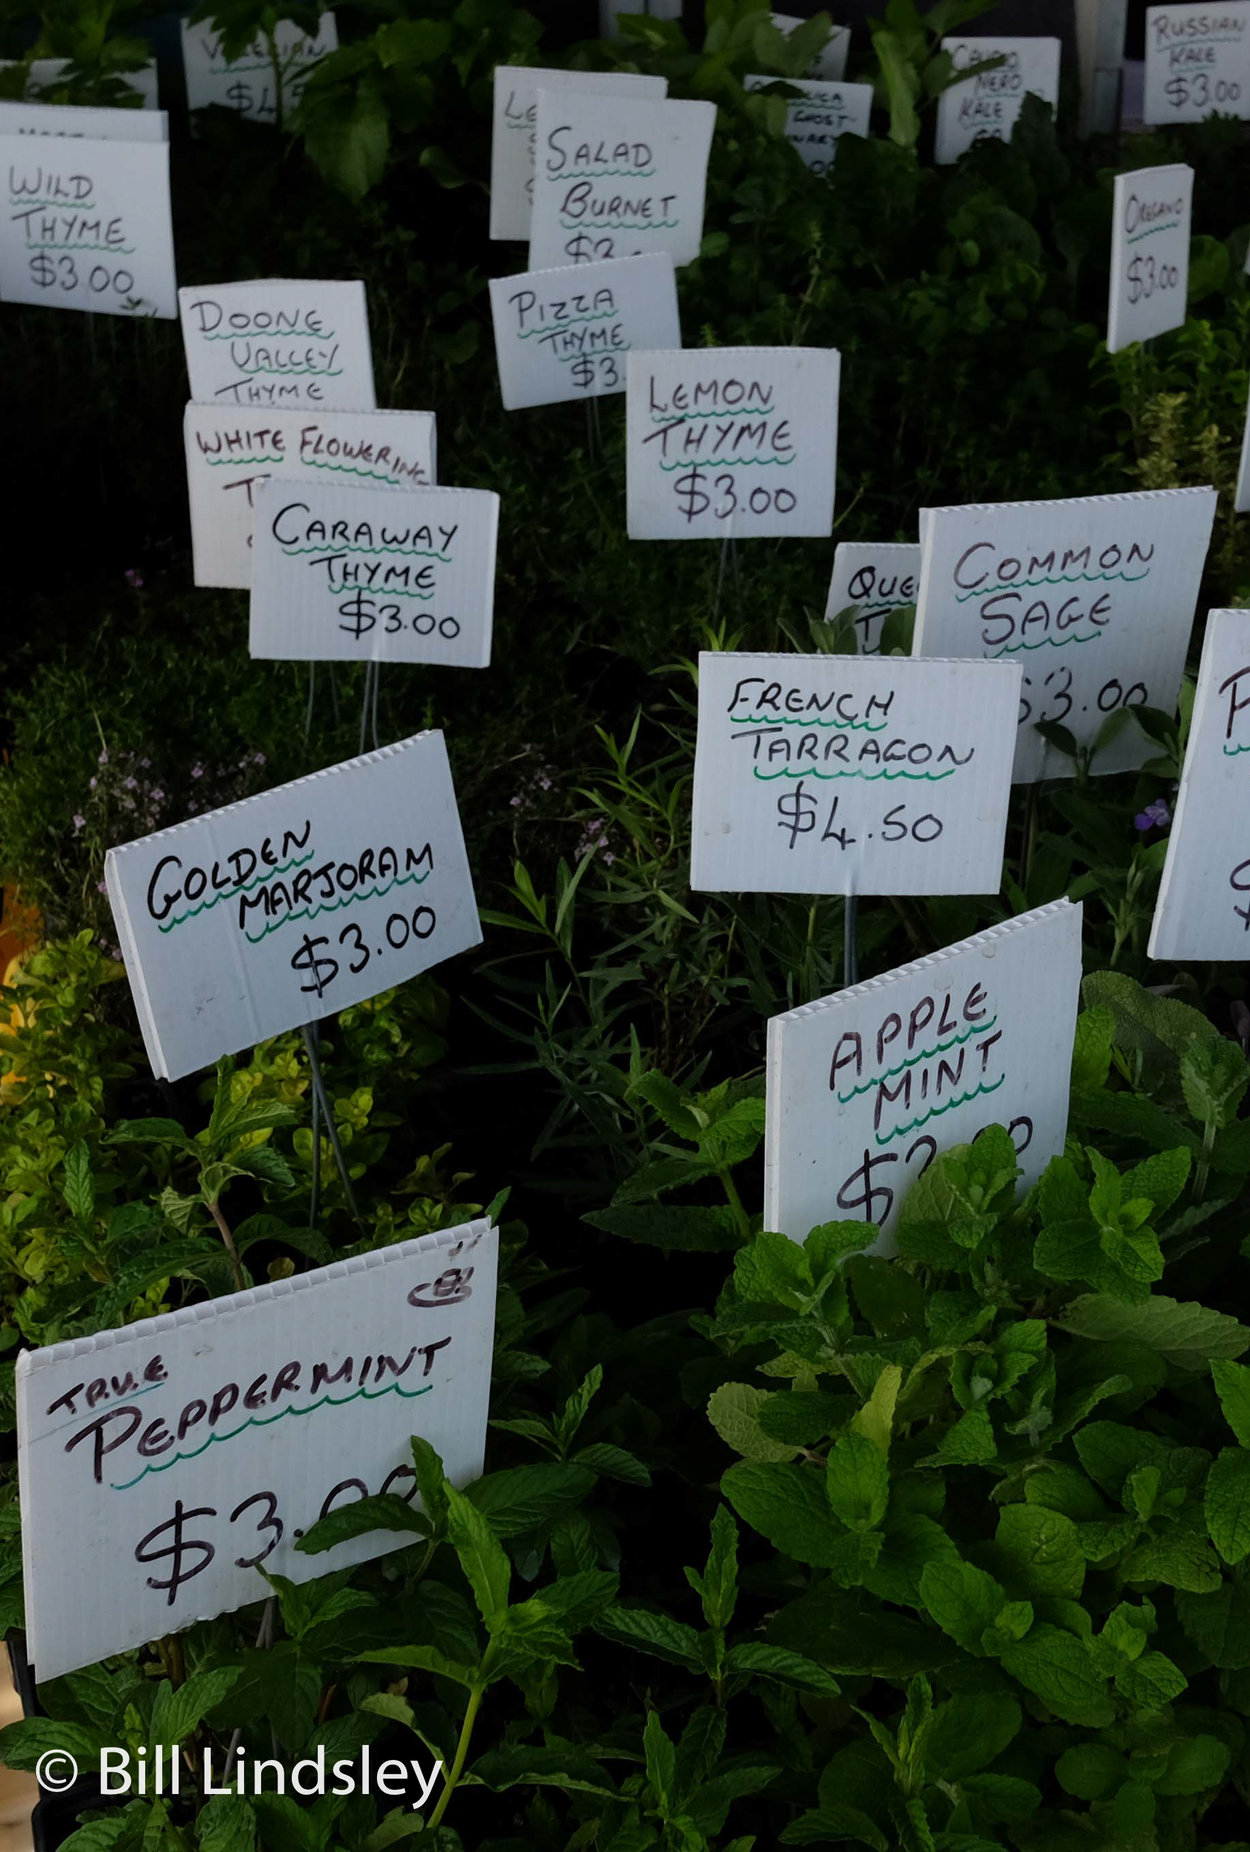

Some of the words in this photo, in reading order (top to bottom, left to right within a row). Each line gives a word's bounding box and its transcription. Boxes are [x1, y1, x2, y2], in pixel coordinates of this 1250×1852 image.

[545, 126, 654, 172] SALAD
[9, 165, 94, 200] WILD
[560, 181, 676, 218] BURNET
[11, 206, 127, 244] THYME
[190, 300, 323, 333] DOONE
[508, 288, 616, 329] PIZZA
[538, 323, 625, 354] THYME
[213, 377, 325, 405] THYME
[649, 376, 773, 413] LEMON
[196, 429, 286, 455] WHITE
[642, 419, 793, 457] THYME
[673, 464, 798, 523] $3.00
[272, 503, 458, 552] CARAWAY
[309, 553, 437, 589] THYME
[952, 542, 1154, 590] COMMON
[338, 588, 461, 641] $3.00
[979, 592, 1112, 646] SAGE
[727, 677, 895, 721] FRENCH
[731, 726, 975, 766] TARRAGON
[777, 780, 944, 850] $4.50
[146, 820, 311, 920] GOLDEN
[238, 843, 434, 930] MARJORAM
[290, 905, 437, 999] $3.00
[829, 981, 988, 1091] APPLE
[873, 1029, 1003, 1131] MINT
[46, 1354, 169, 1416] TRUE
[64, 1336, 452, 1484] PEPPERMINT
